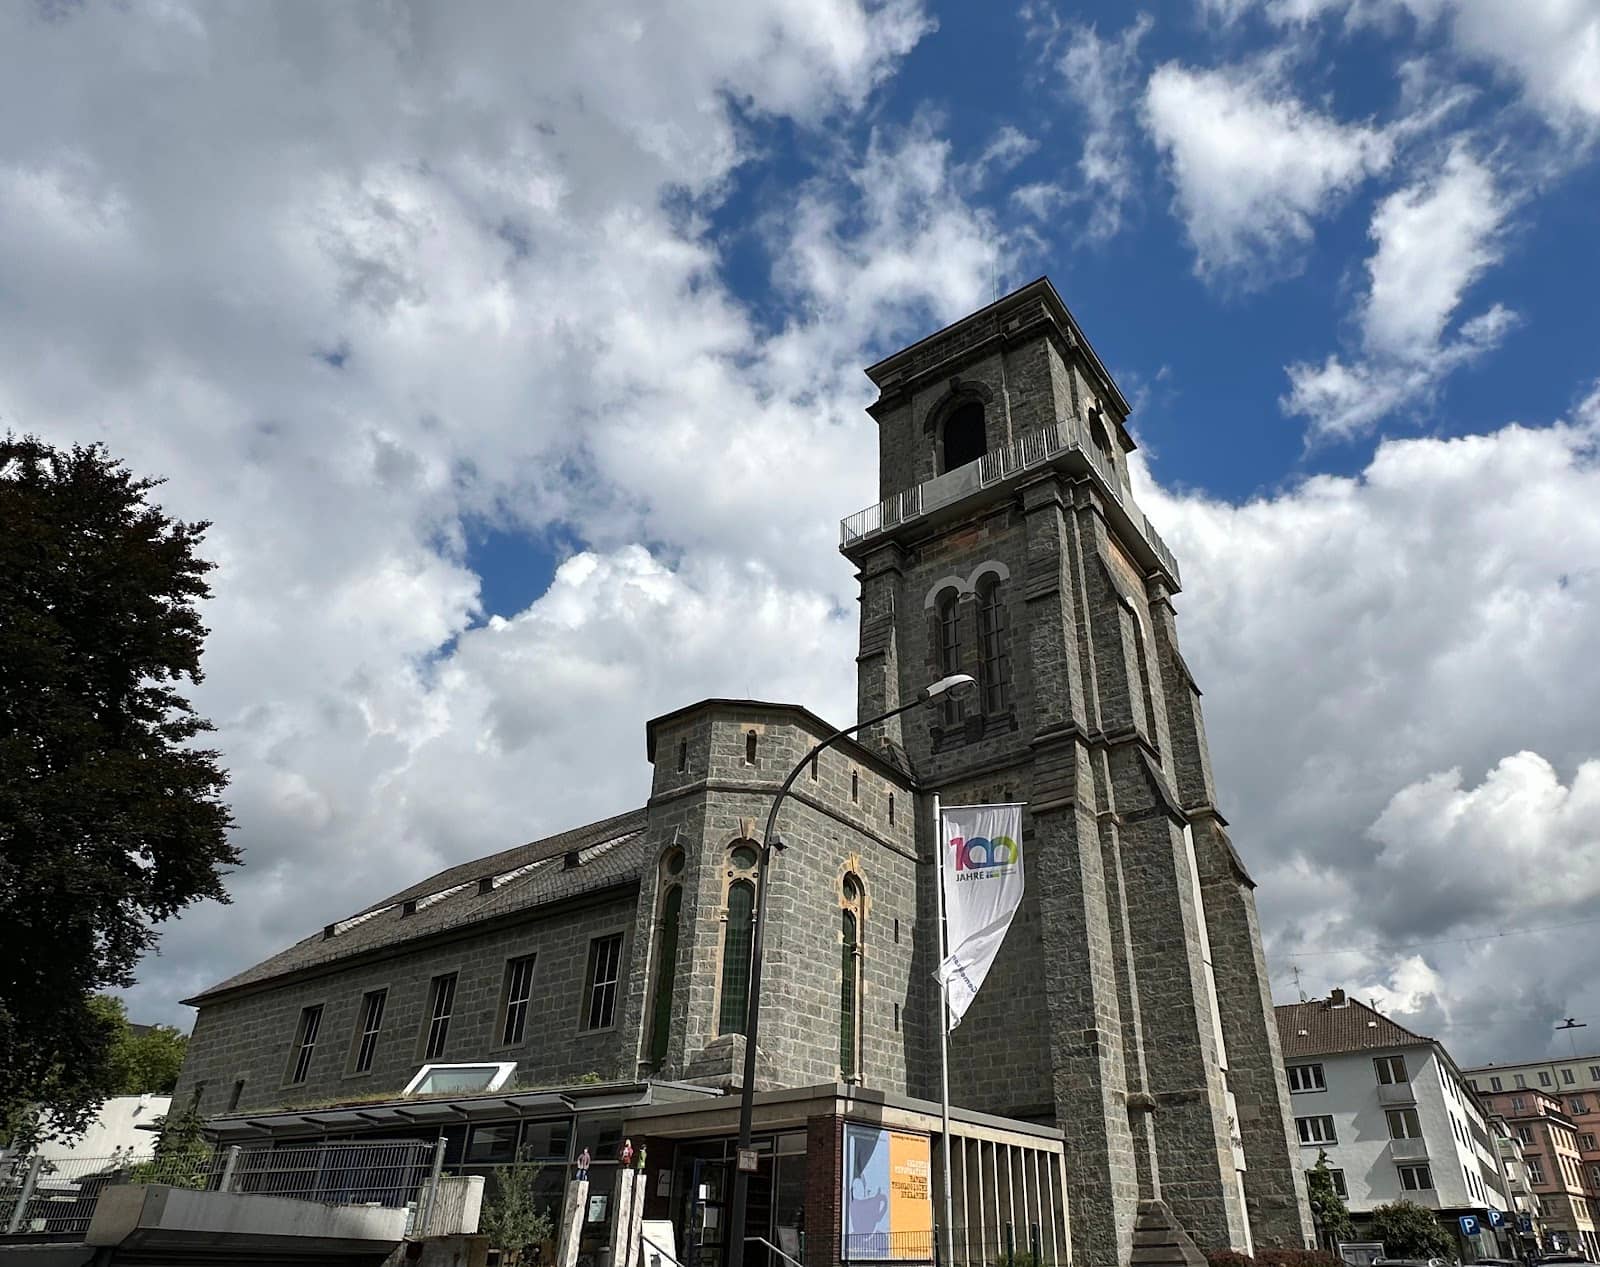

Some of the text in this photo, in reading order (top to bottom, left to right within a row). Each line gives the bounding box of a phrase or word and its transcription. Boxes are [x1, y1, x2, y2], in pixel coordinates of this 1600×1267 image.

[950, 836, 1018, 871] 100
[956, 872, 984, 882] JAHRE
[1464, 1218, 1474, 1233] P
[1491, 1212, 1500, 1225] P
